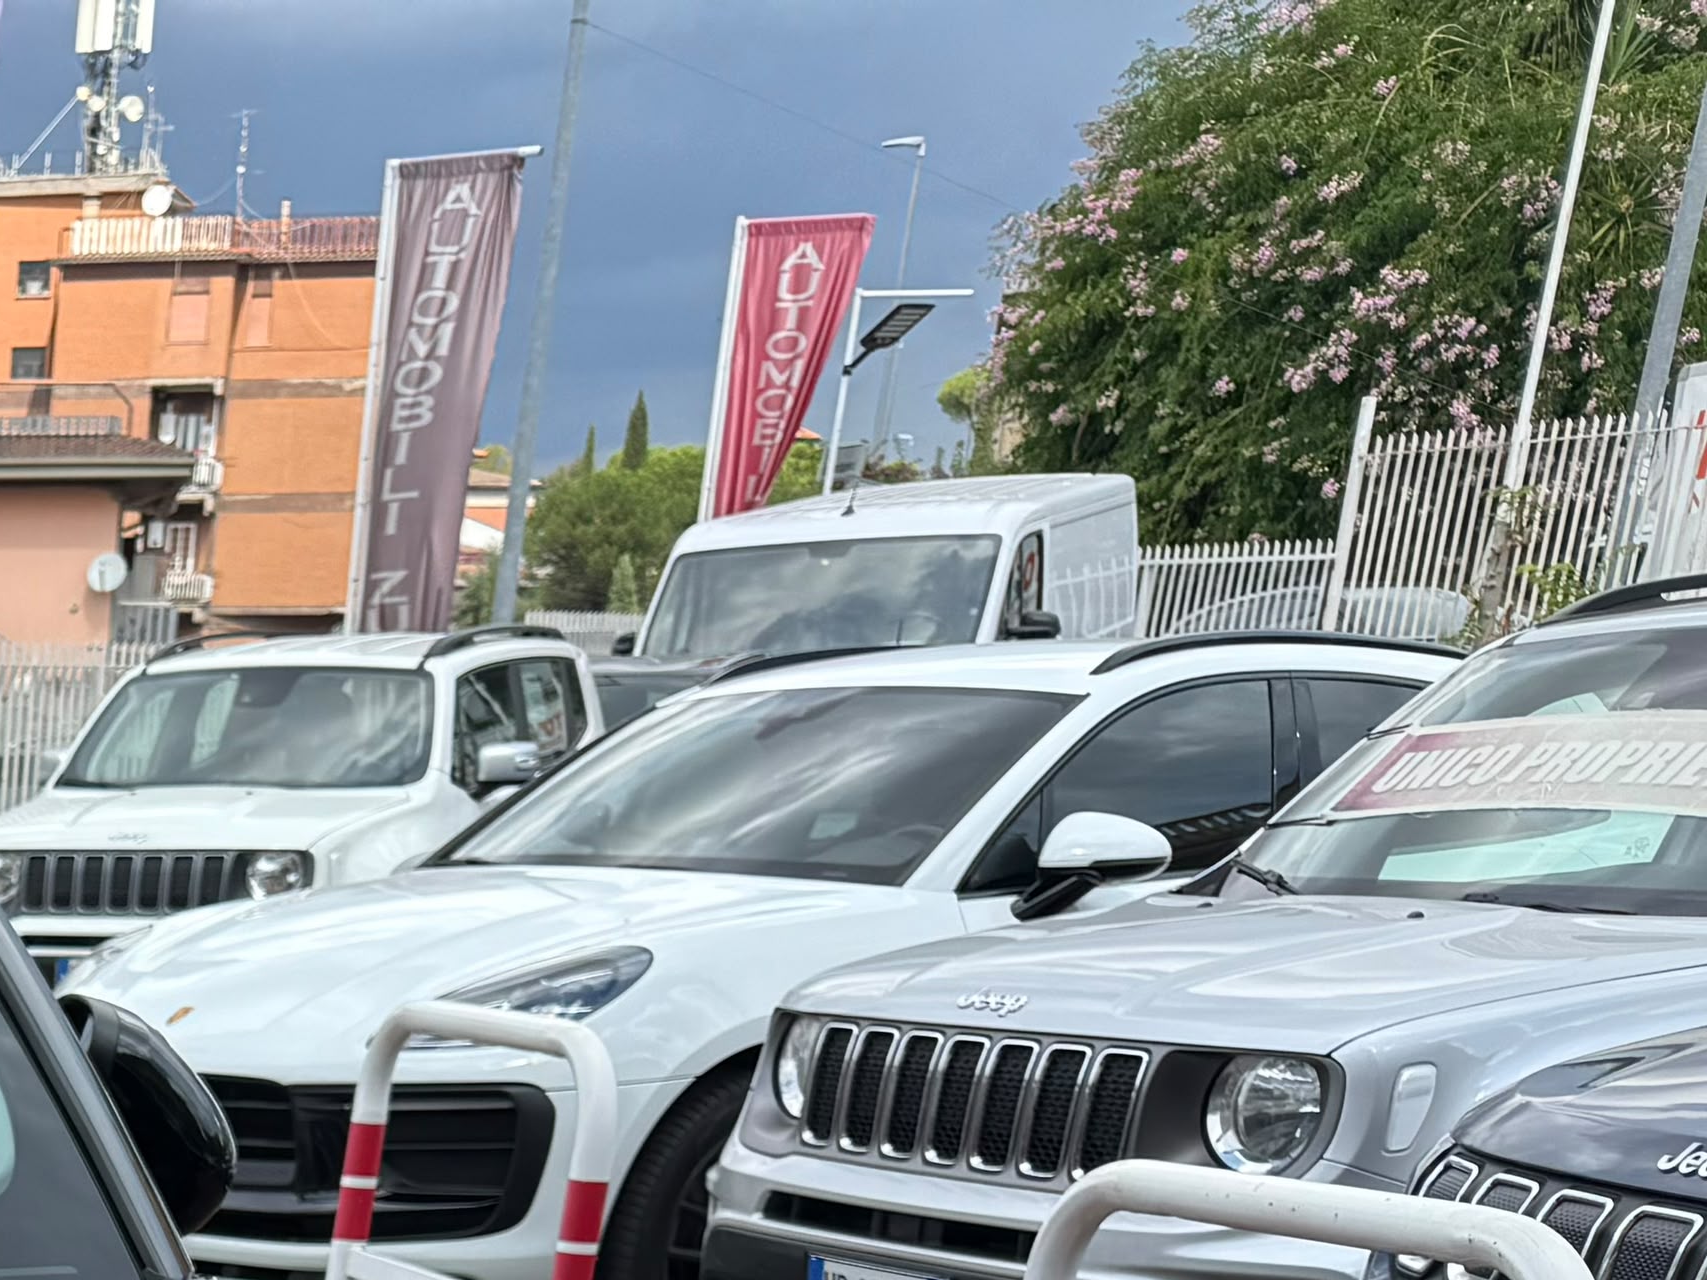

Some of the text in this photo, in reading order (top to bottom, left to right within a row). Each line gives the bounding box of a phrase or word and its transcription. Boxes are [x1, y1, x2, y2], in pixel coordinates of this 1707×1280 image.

[382, 182, 481, 537] AUTOMOBILI
[1371, 743, 1525, 794] UNICO
[956, 986, 1029, 1018] Jeep
